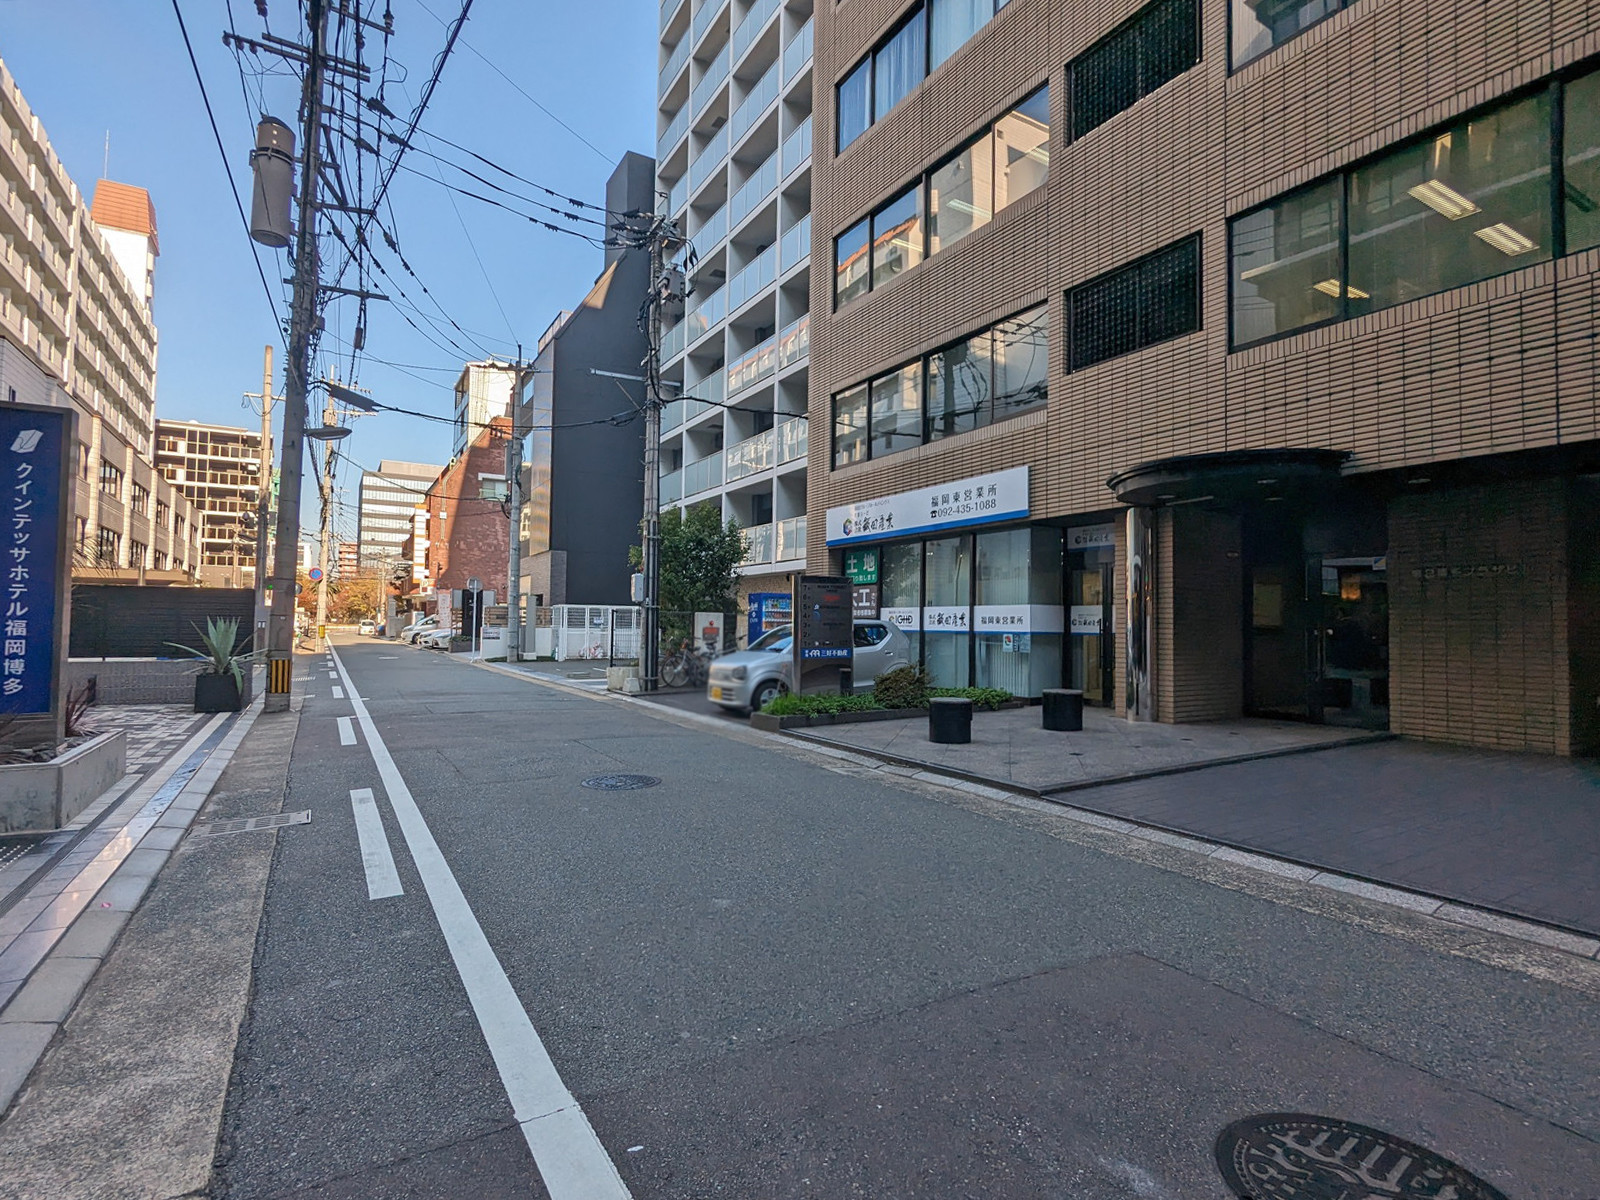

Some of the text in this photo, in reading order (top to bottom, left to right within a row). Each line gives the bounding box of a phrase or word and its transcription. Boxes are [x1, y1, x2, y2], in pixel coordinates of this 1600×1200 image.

[931, 483, 997, 507] 福岡東営業所
[937, 498, 997, 518] 092-435-1088
[846, 552, 875, 574] 土地
[3, 462, 33, 696] クインテッサホテル福岡博多
[981, 615, 1024, 625] 福岡東営業所
